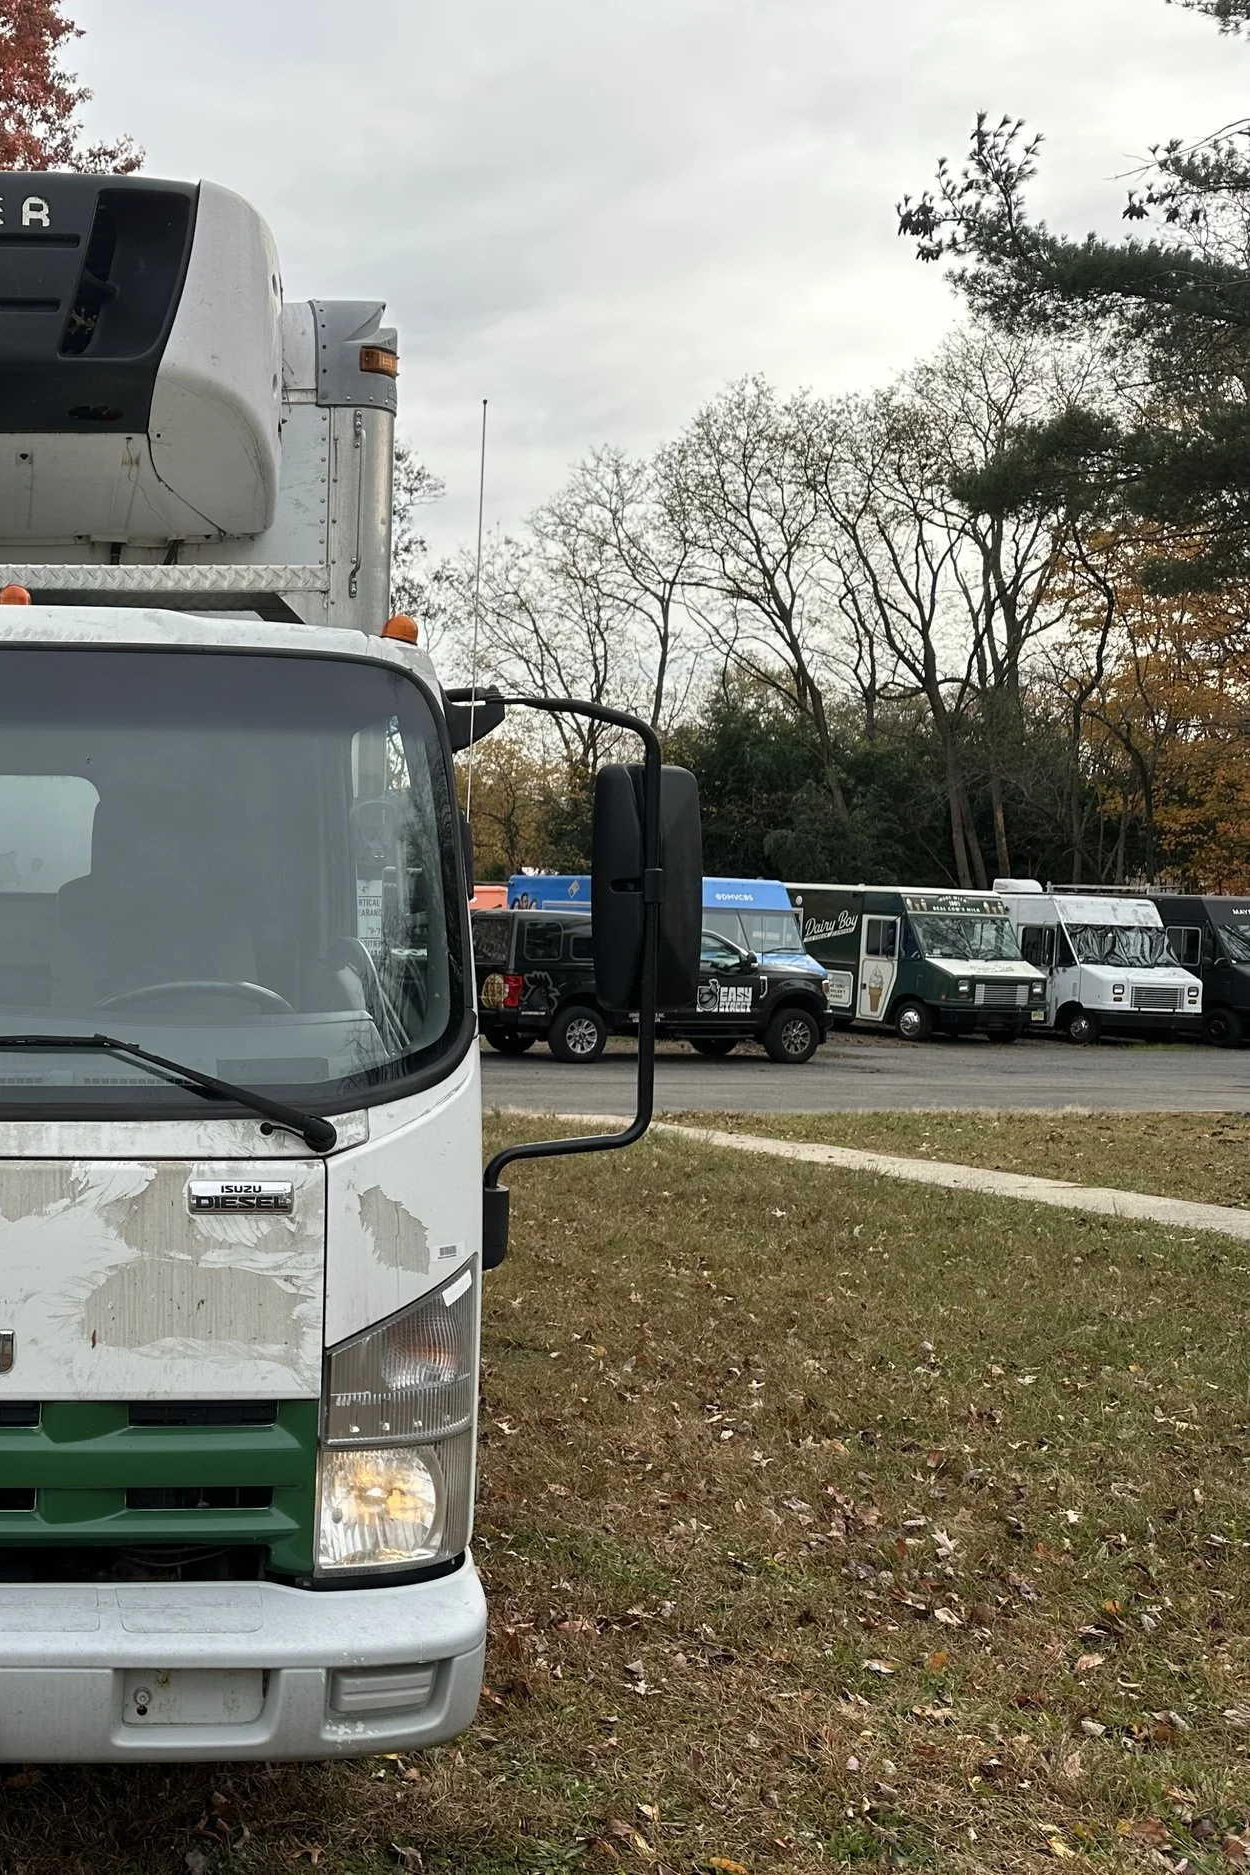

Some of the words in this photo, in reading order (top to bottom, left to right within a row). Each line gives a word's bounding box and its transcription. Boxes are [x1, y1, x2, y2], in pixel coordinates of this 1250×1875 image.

[805, 917, 836, 937] Dairy
[838, 910, 859, 932] Boy
[720, 986, 752, 1002] EASY
[719, 1001, 751, 1013] STREET
[221, 1185, 262, 1193] ISUZU
[195, 1196, 289, 1209] DIESEL
